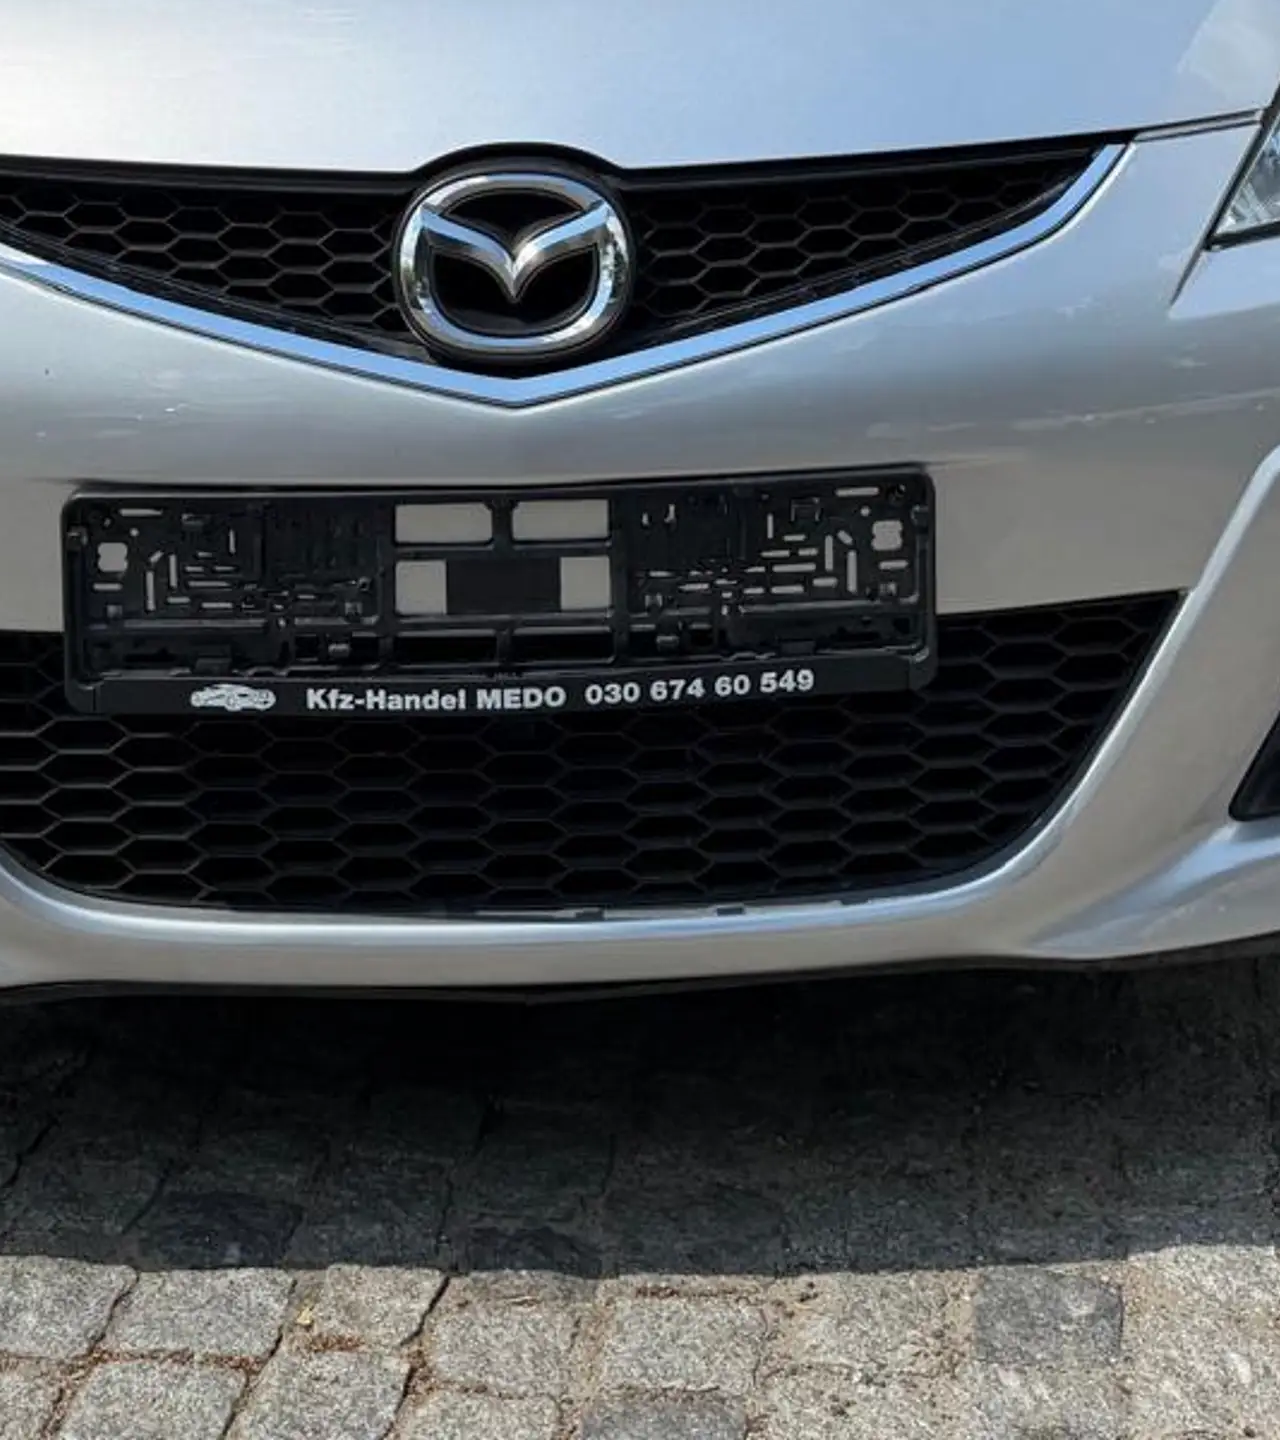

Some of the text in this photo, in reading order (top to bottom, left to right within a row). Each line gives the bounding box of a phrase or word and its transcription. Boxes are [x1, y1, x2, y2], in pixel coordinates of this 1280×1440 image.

[305, 669, 815, 711] Kfz-Handel MEDO 030 674 60 549
